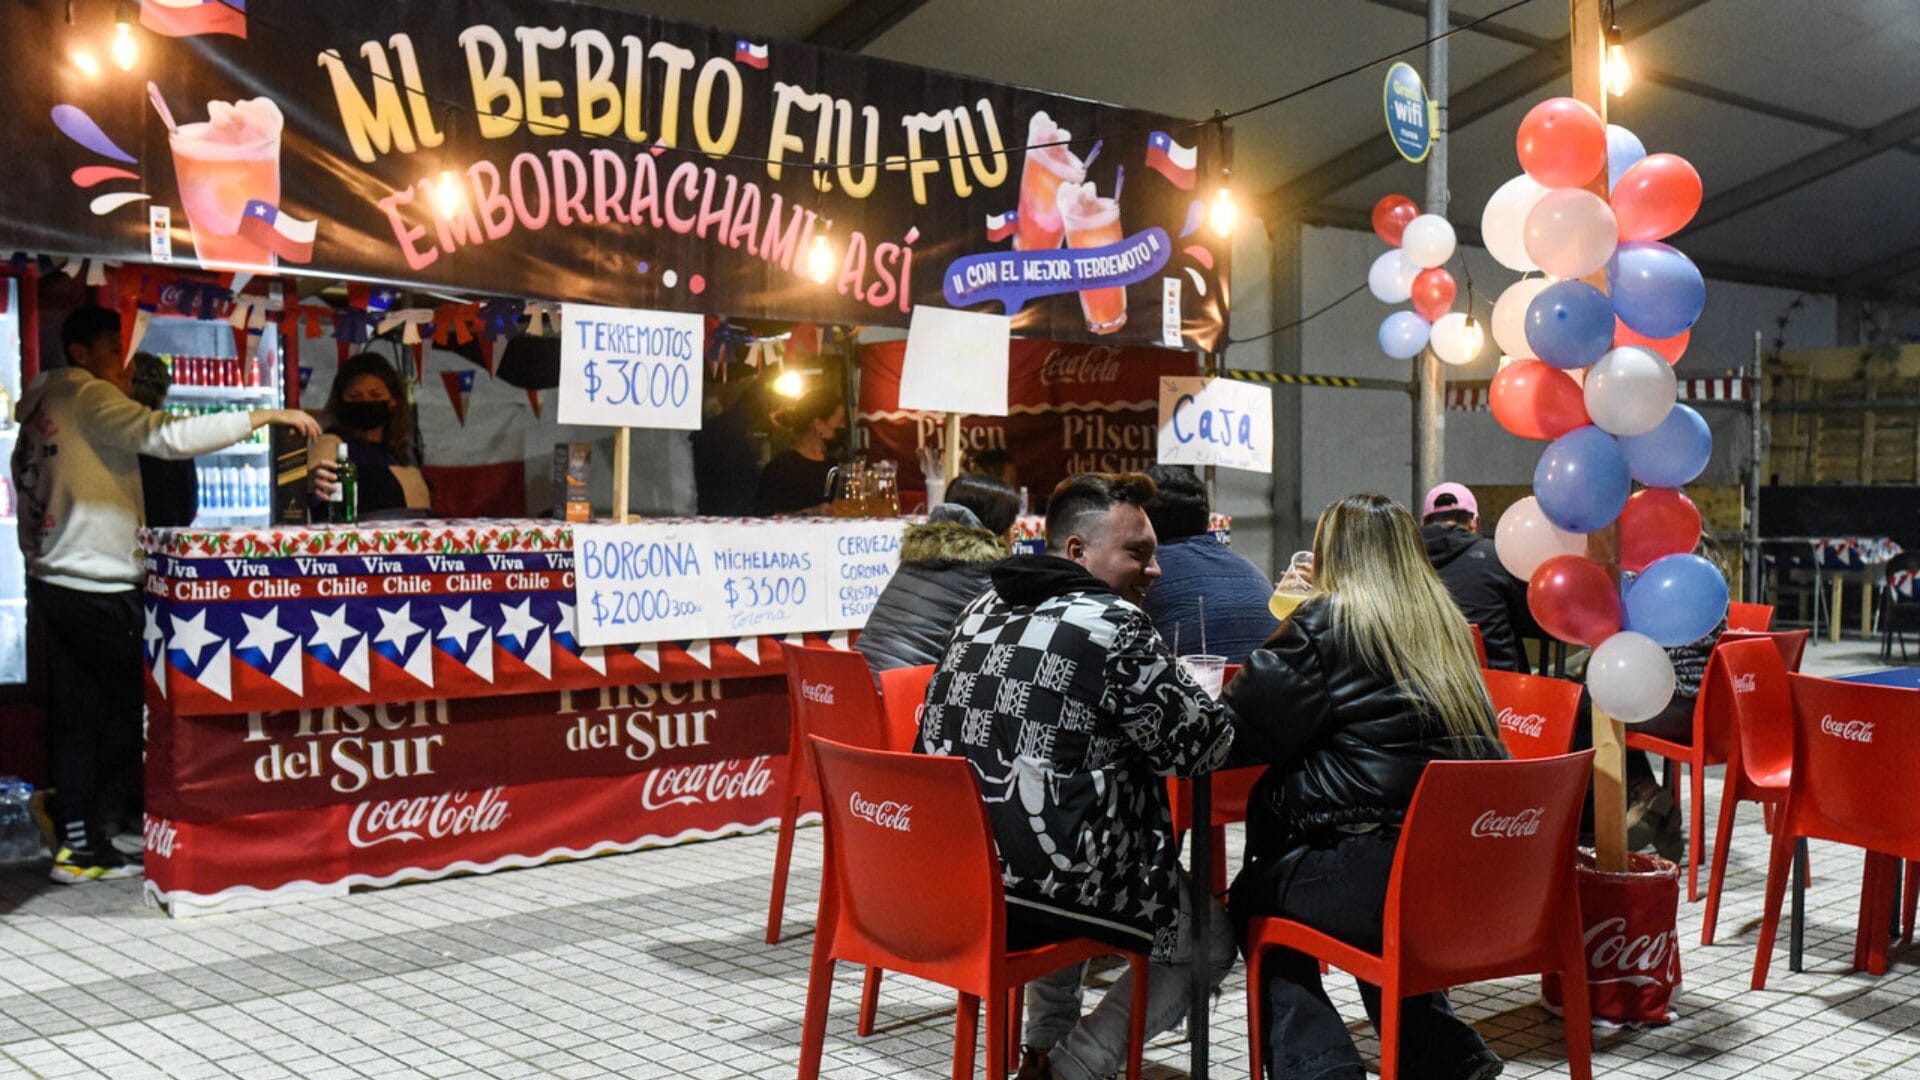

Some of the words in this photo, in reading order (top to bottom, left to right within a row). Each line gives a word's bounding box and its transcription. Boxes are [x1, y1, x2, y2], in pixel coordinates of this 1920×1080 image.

[317, 33, 444, 163] MI
[458, 24, 743, 159] BEBITO
[766, 81, 1008, 205] FIU-FIU
[1394, 100, 1423, 128] wifi
[837, 225, 921, 313] ASÍ
[966, 262, 998, 288] CON
[1001, 259, 1019, 281] EL
[1023, 257, 1072, 282] MEJOR
[1074, 242, 1151, 279] TERREMOTO
[575, 320, 693, 361] TERREMOTOS
[583, 358, 690, 408] $3000
[916, 416, 1008, 451] Pisen
[224, 558, 271, 577] Viva
[295, 556, 338, 576] Viva
[361, 555, 403, 573] Viva
[426, 554, 465, 572] Viva
[487, 553, 524, 571] Viva
[837, 535, 899, 556] CERVEZA
[175, 580, 232, 600] Chile
[248, 579, 300, 598] Chile
[317, 577, 368, 596] Chile
[382, 575, 432, 593] Chile
[445, 573, 493, 592] Chile
[505, 572, 550, 590] Chile
[841, 563, 890, 580] CORONA
[592, 588, 669, 627] $2000
[724, 575, 806, 610] $3500
[566, 713, 619, 752] del
[625, 709, 718, 761] Sur
[1820, 714, 1875, 743] Coca-Cola
[254, 740, 324, 783] del
[330, 734, 445, 794] Sur
[642, 754, 775, 811] Coca-Cola
[348, 784, 512, 849] Coca-Cola
[850, 791, 912, 833] Coca-Cola
[1471, 807, 1546, 838] Coca-Cola
